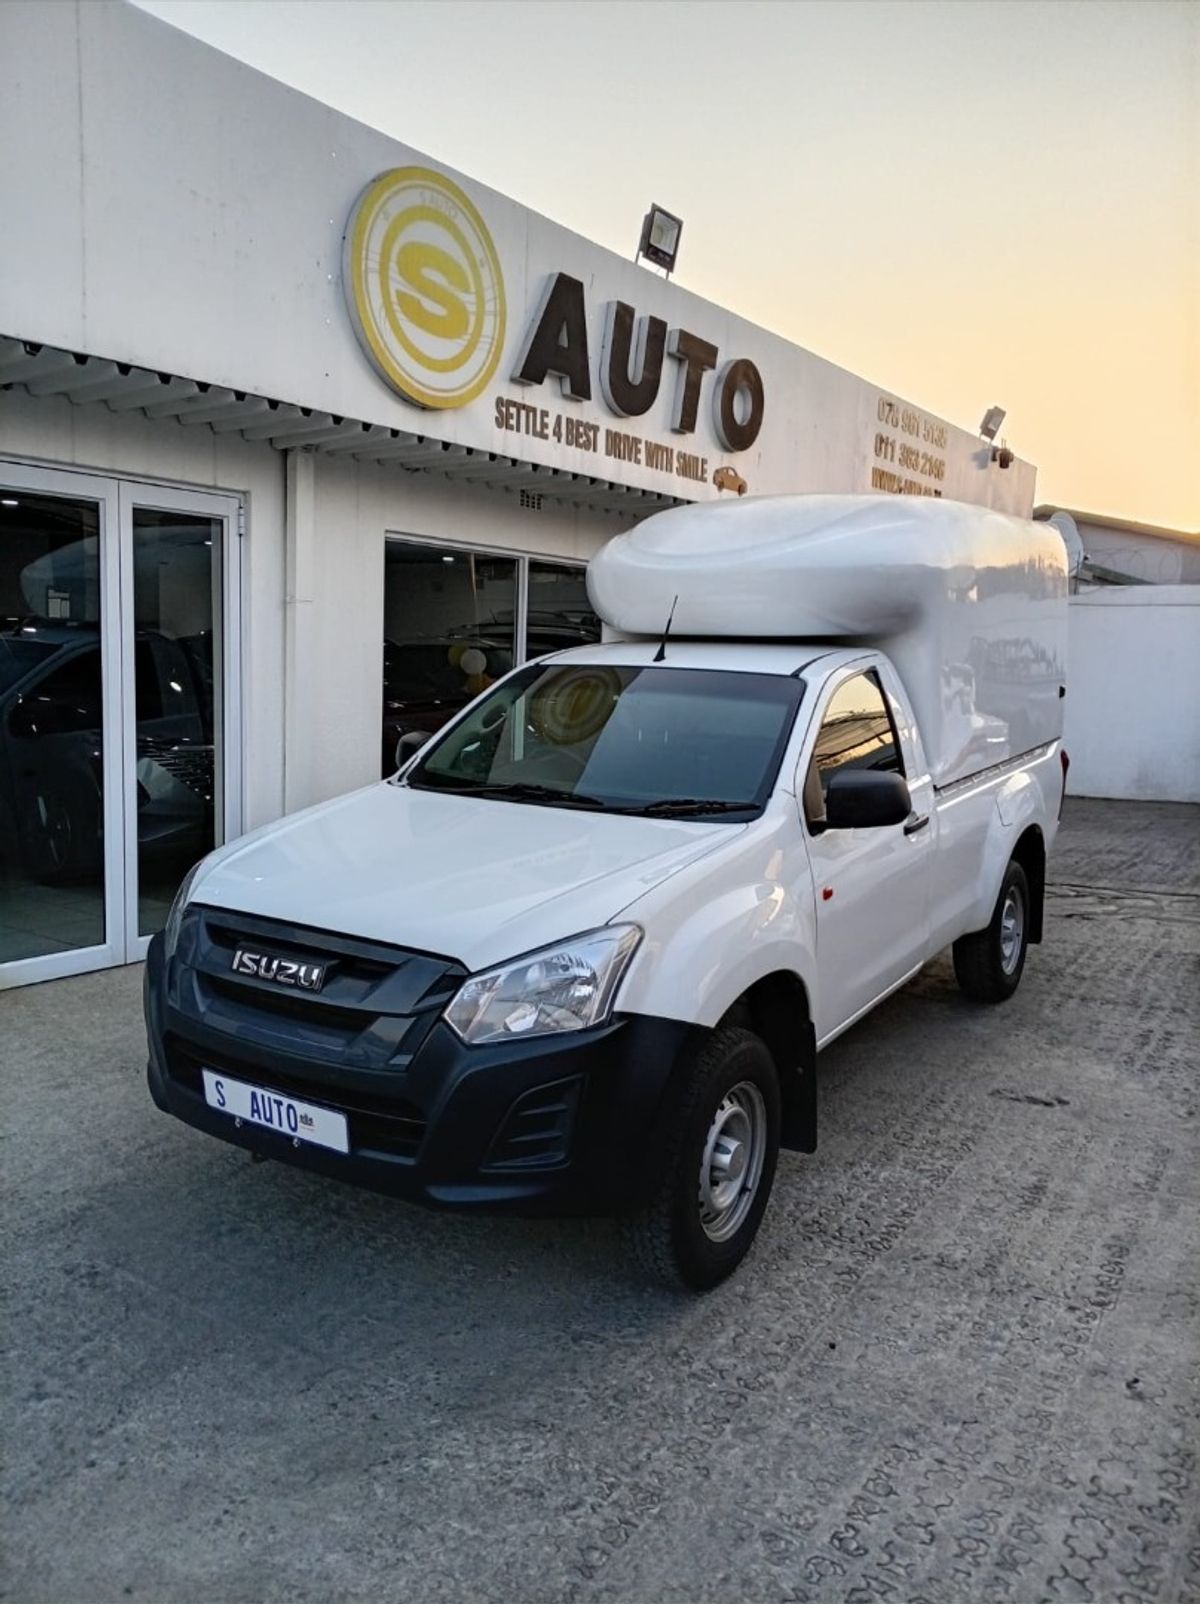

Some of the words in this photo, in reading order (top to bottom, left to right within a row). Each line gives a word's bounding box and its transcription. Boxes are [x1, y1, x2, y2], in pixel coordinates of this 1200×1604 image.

[510, 271, 765, 453] AUTO
[494, 395, 550, 440] SETTLE
[552, 414, 562, 443] 4
[565, 417, 600, 453] BEST
[605, 428, 642, 465] DRIVE
[645, 439, 674, 474] WITH
[675, 450, 708, 484] SMILE
[231, 949, 323, 991] ISUZU
[214, 1080, 226, 1108] S
[250, 1090, 299, 1133] AUTO
